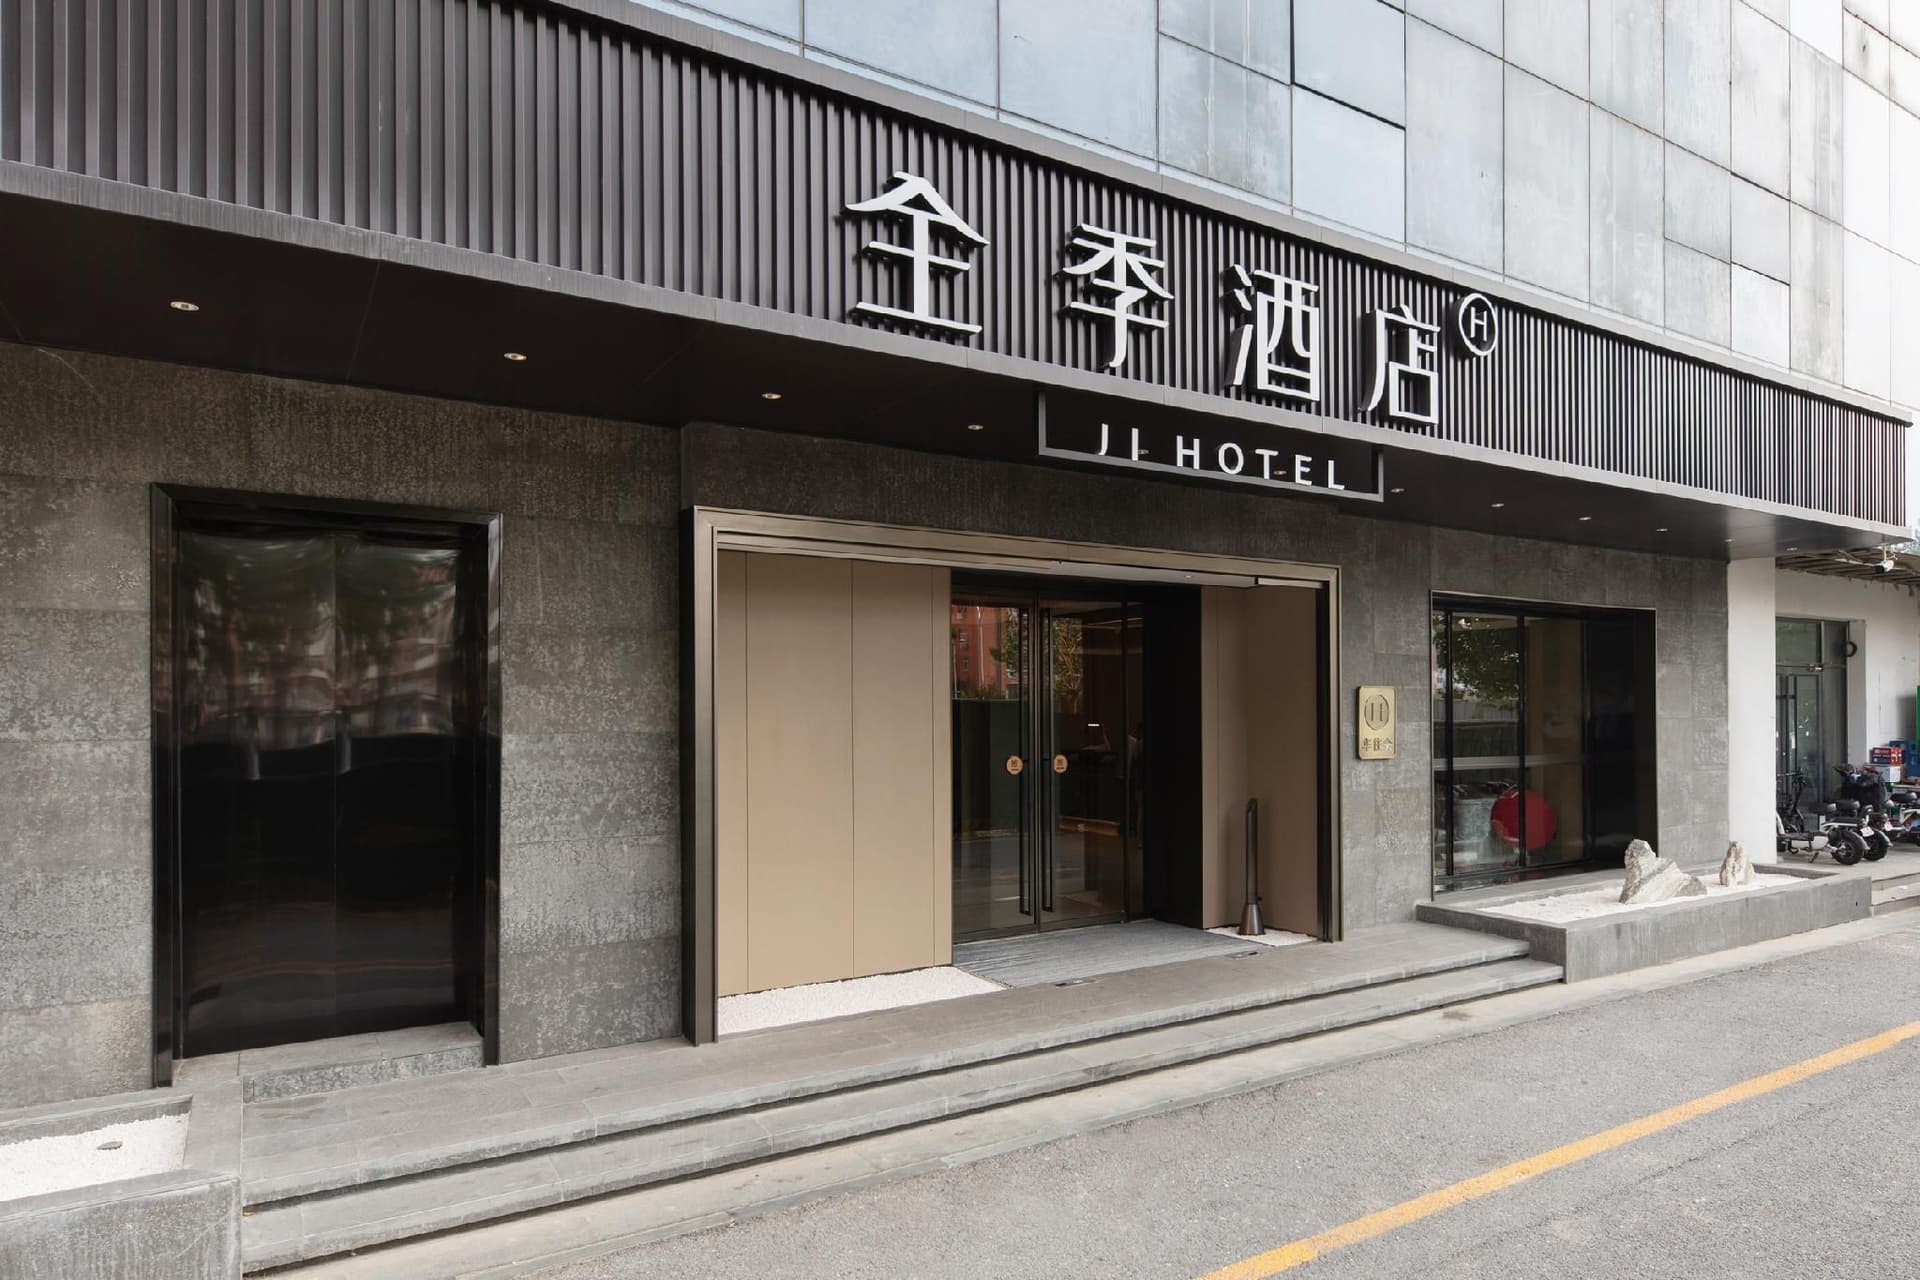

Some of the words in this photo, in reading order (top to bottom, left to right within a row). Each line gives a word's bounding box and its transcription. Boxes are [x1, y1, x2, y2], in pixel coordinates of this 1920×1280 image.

[845, 171, 1441, 425] 全季酒店
[1098, 423, 1139, 461] JI
[1176, 435, 1345, 490] HOTEL
